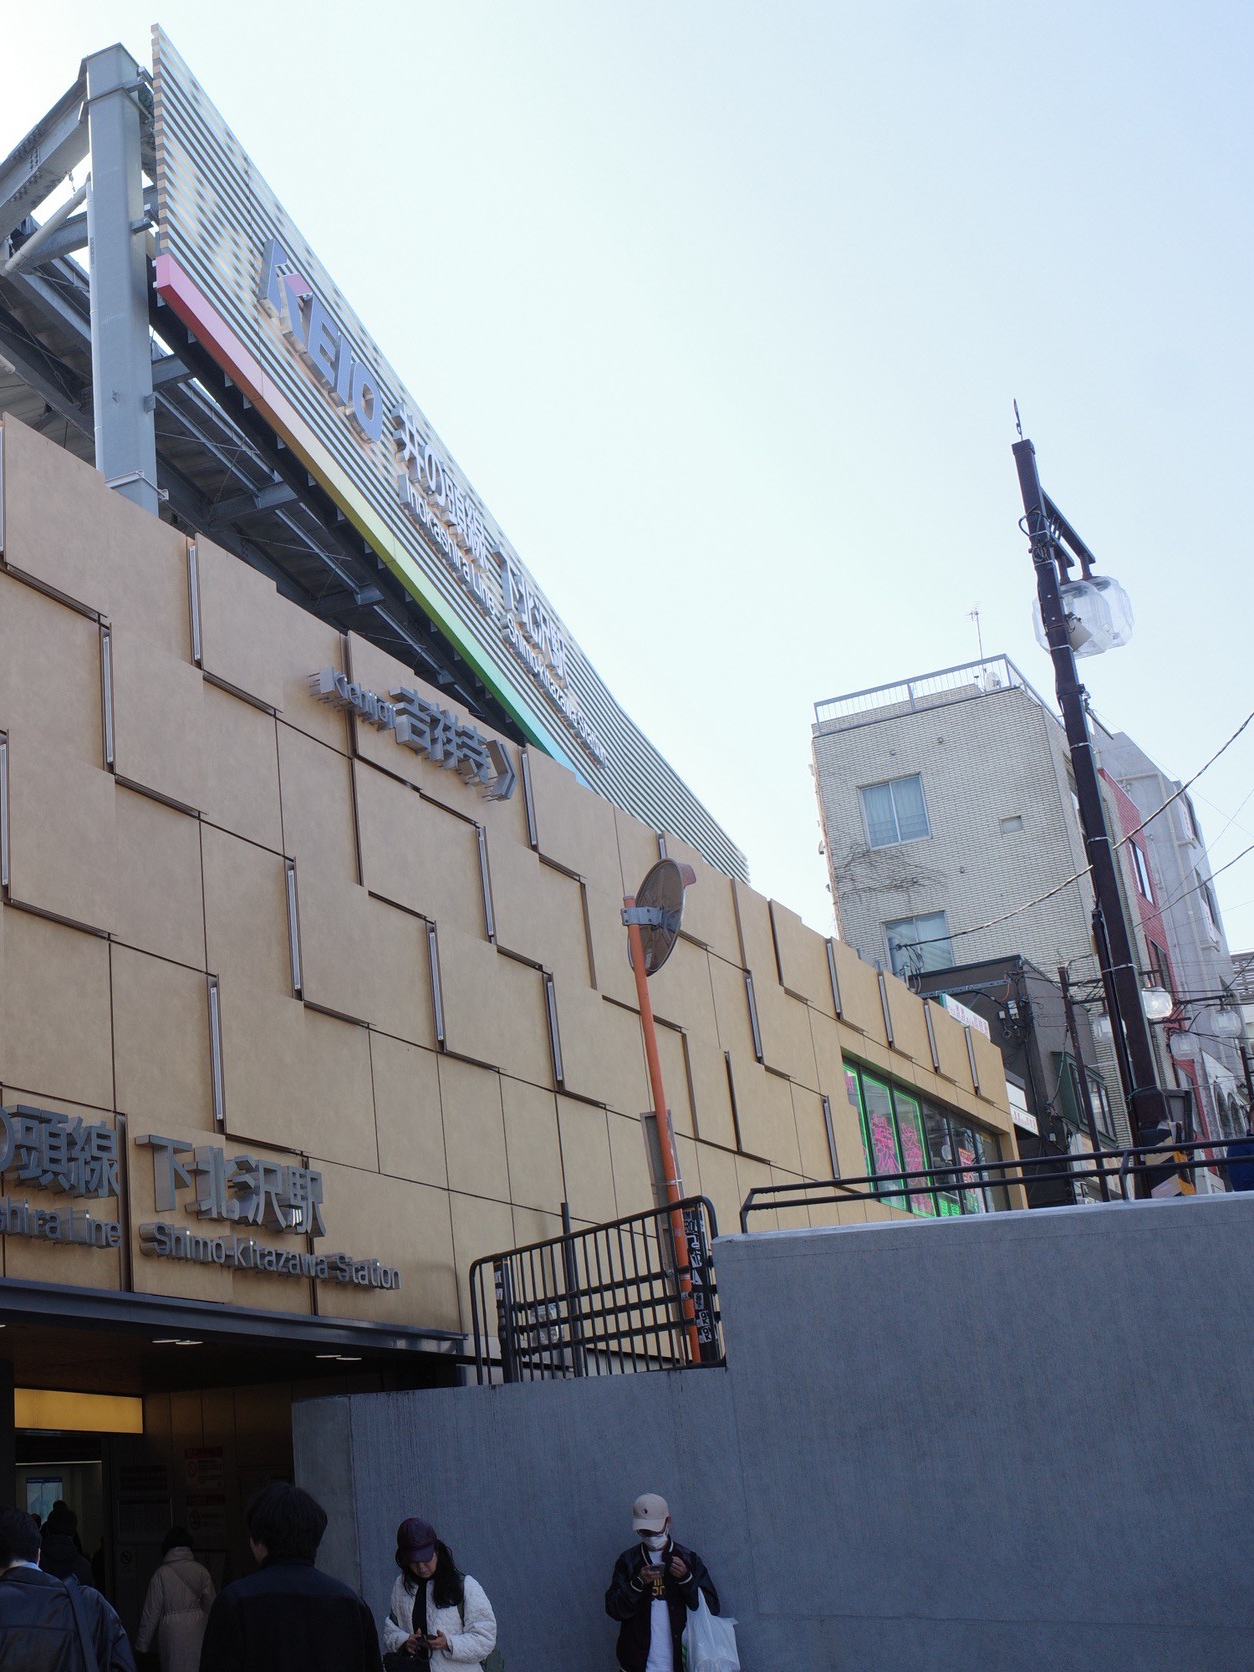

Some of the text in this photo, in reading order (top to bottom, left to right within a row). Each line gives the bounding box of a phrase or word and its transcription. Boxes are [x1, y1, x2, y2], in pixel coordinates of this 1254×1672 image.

[259, 239, 383, 443] KEIO
[389, 686, 491, 787] 吉祥寺
[59, 1207, 122, 1249] Line
[135, 1134, 326, 1238] 下北沢駅
[324, 1252, 402, 1290] Station
